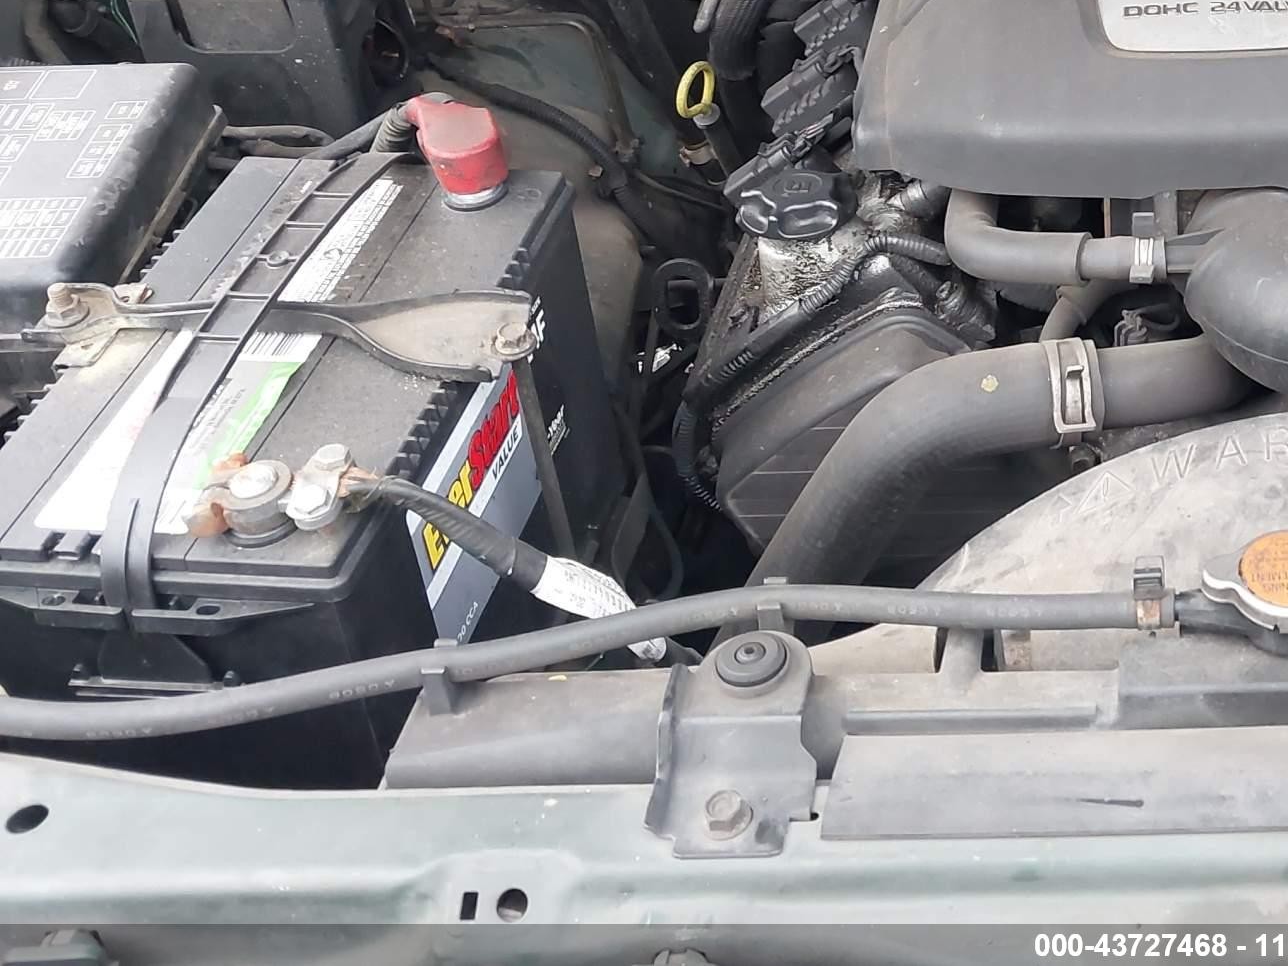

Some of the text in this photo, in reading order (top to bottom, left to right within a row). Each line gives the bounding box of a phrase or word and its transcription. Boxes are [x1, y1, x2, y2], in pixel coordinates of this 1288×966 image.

[1124, 1, 1200, 18] DOHC
[422, 370, 519, 571] EerStart
[492, 425, 519, 480] VALUE
[464, 601, 479, 626] CCA
